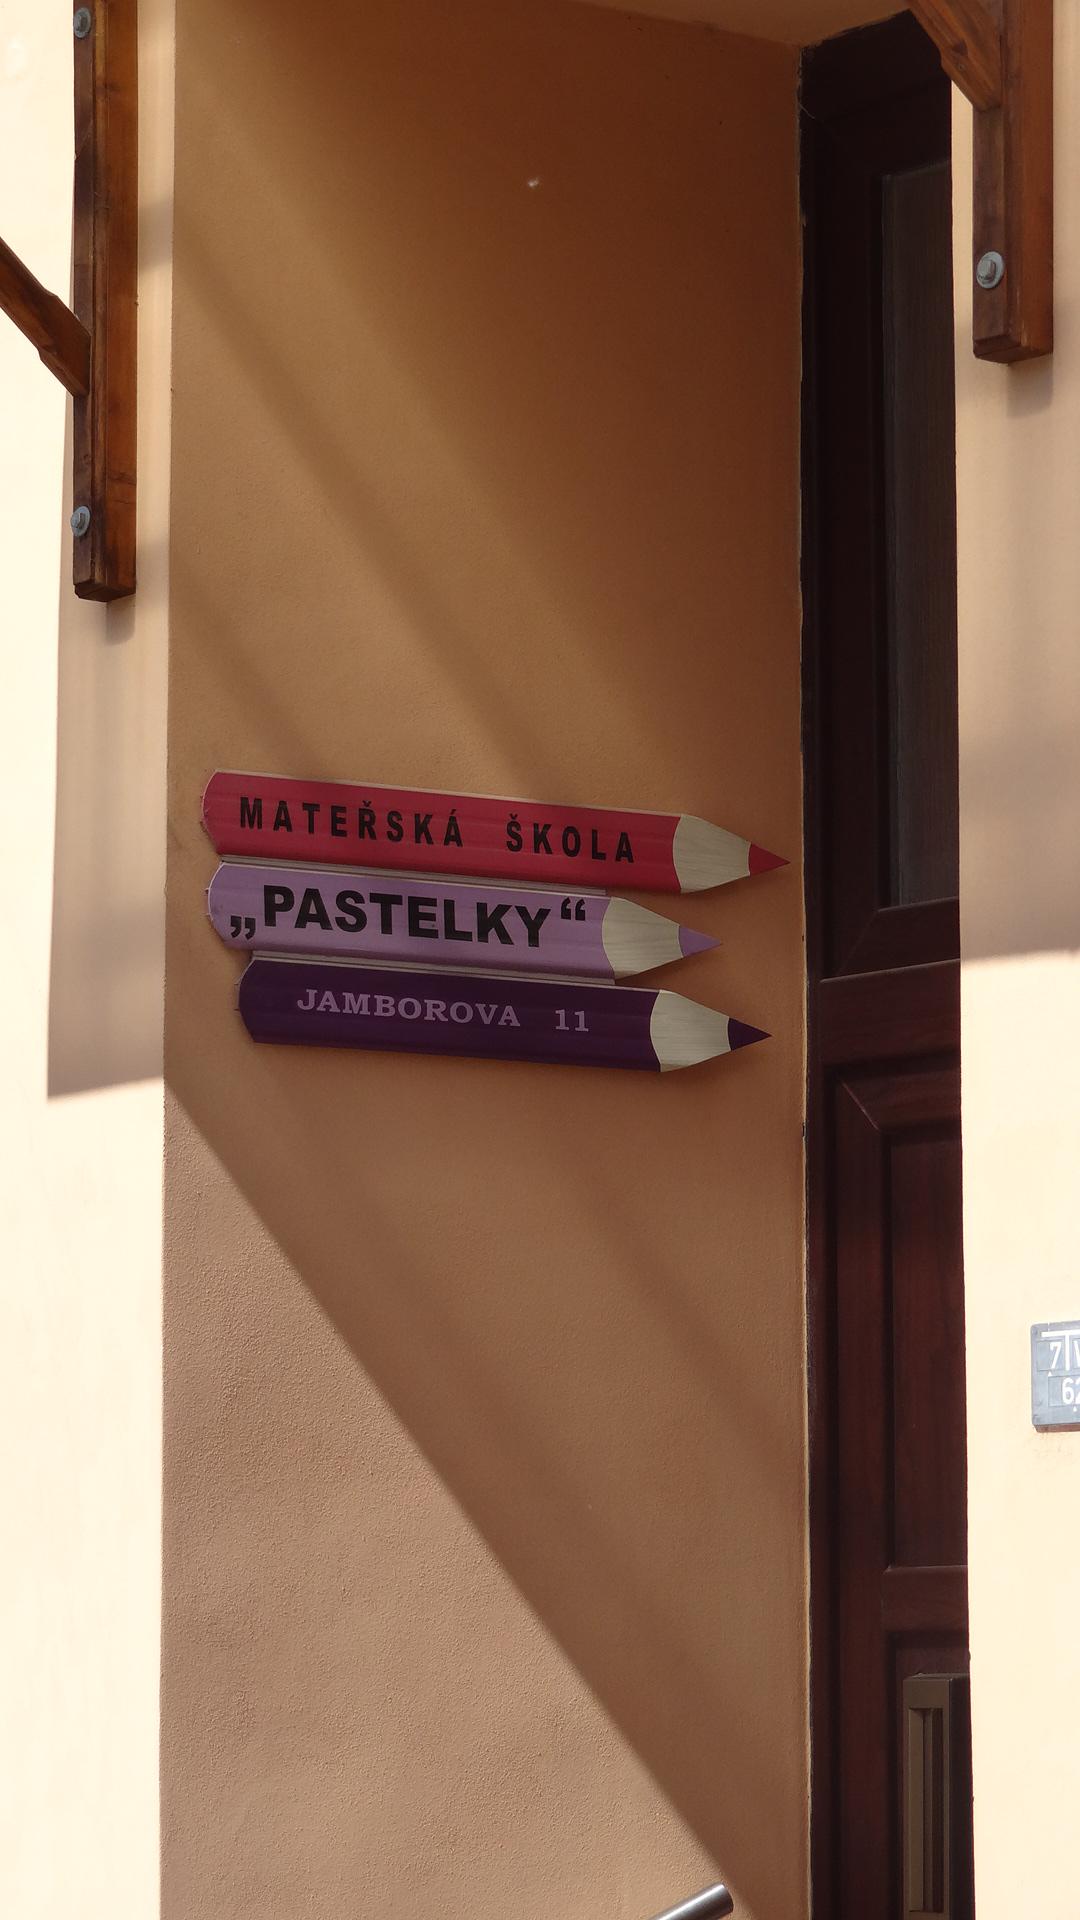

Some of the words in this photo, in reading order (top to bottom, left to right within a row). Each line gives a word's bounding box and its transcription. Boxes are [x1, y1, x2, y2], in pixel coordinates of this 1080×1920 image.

[239, 796, 463, 847] MATEŘSKÁ
[506, 813, 634, 863] ŠKOLA
[296, 988, 521, 1027] JAMBOROVA
[555, 1009, 589, 1032] 11
